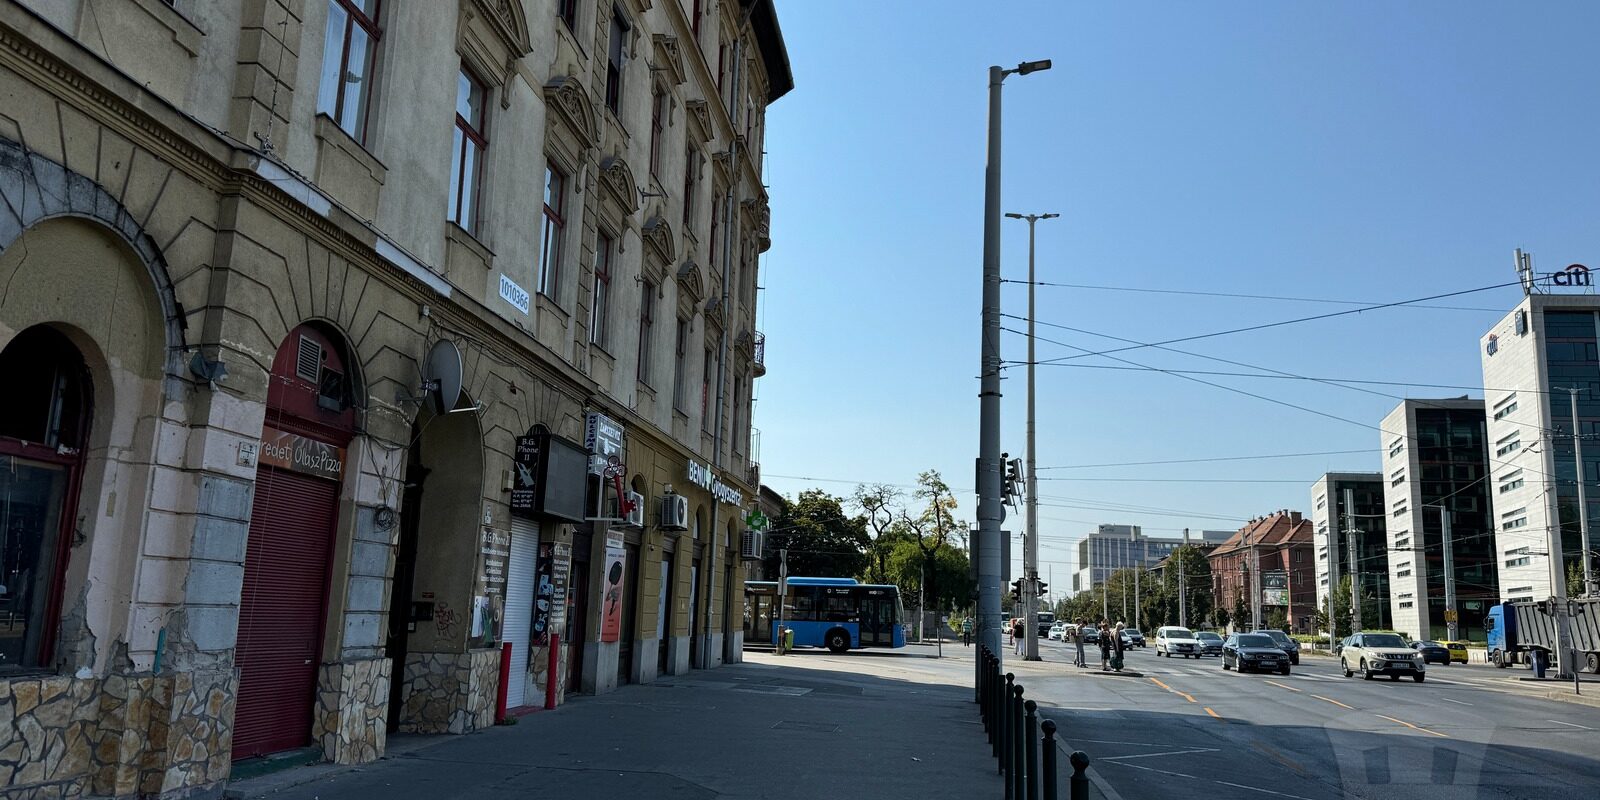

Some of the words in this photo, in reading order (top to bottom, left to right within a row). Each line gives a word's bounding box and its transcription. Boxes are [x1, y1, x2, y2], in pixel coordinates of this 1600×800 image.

[1553, 267, 1589, 286] citi
[501, 278, 528, 310] 1010366
[517, 445, 539, 454] Phone
[688, 459, 706, 488] BENU
